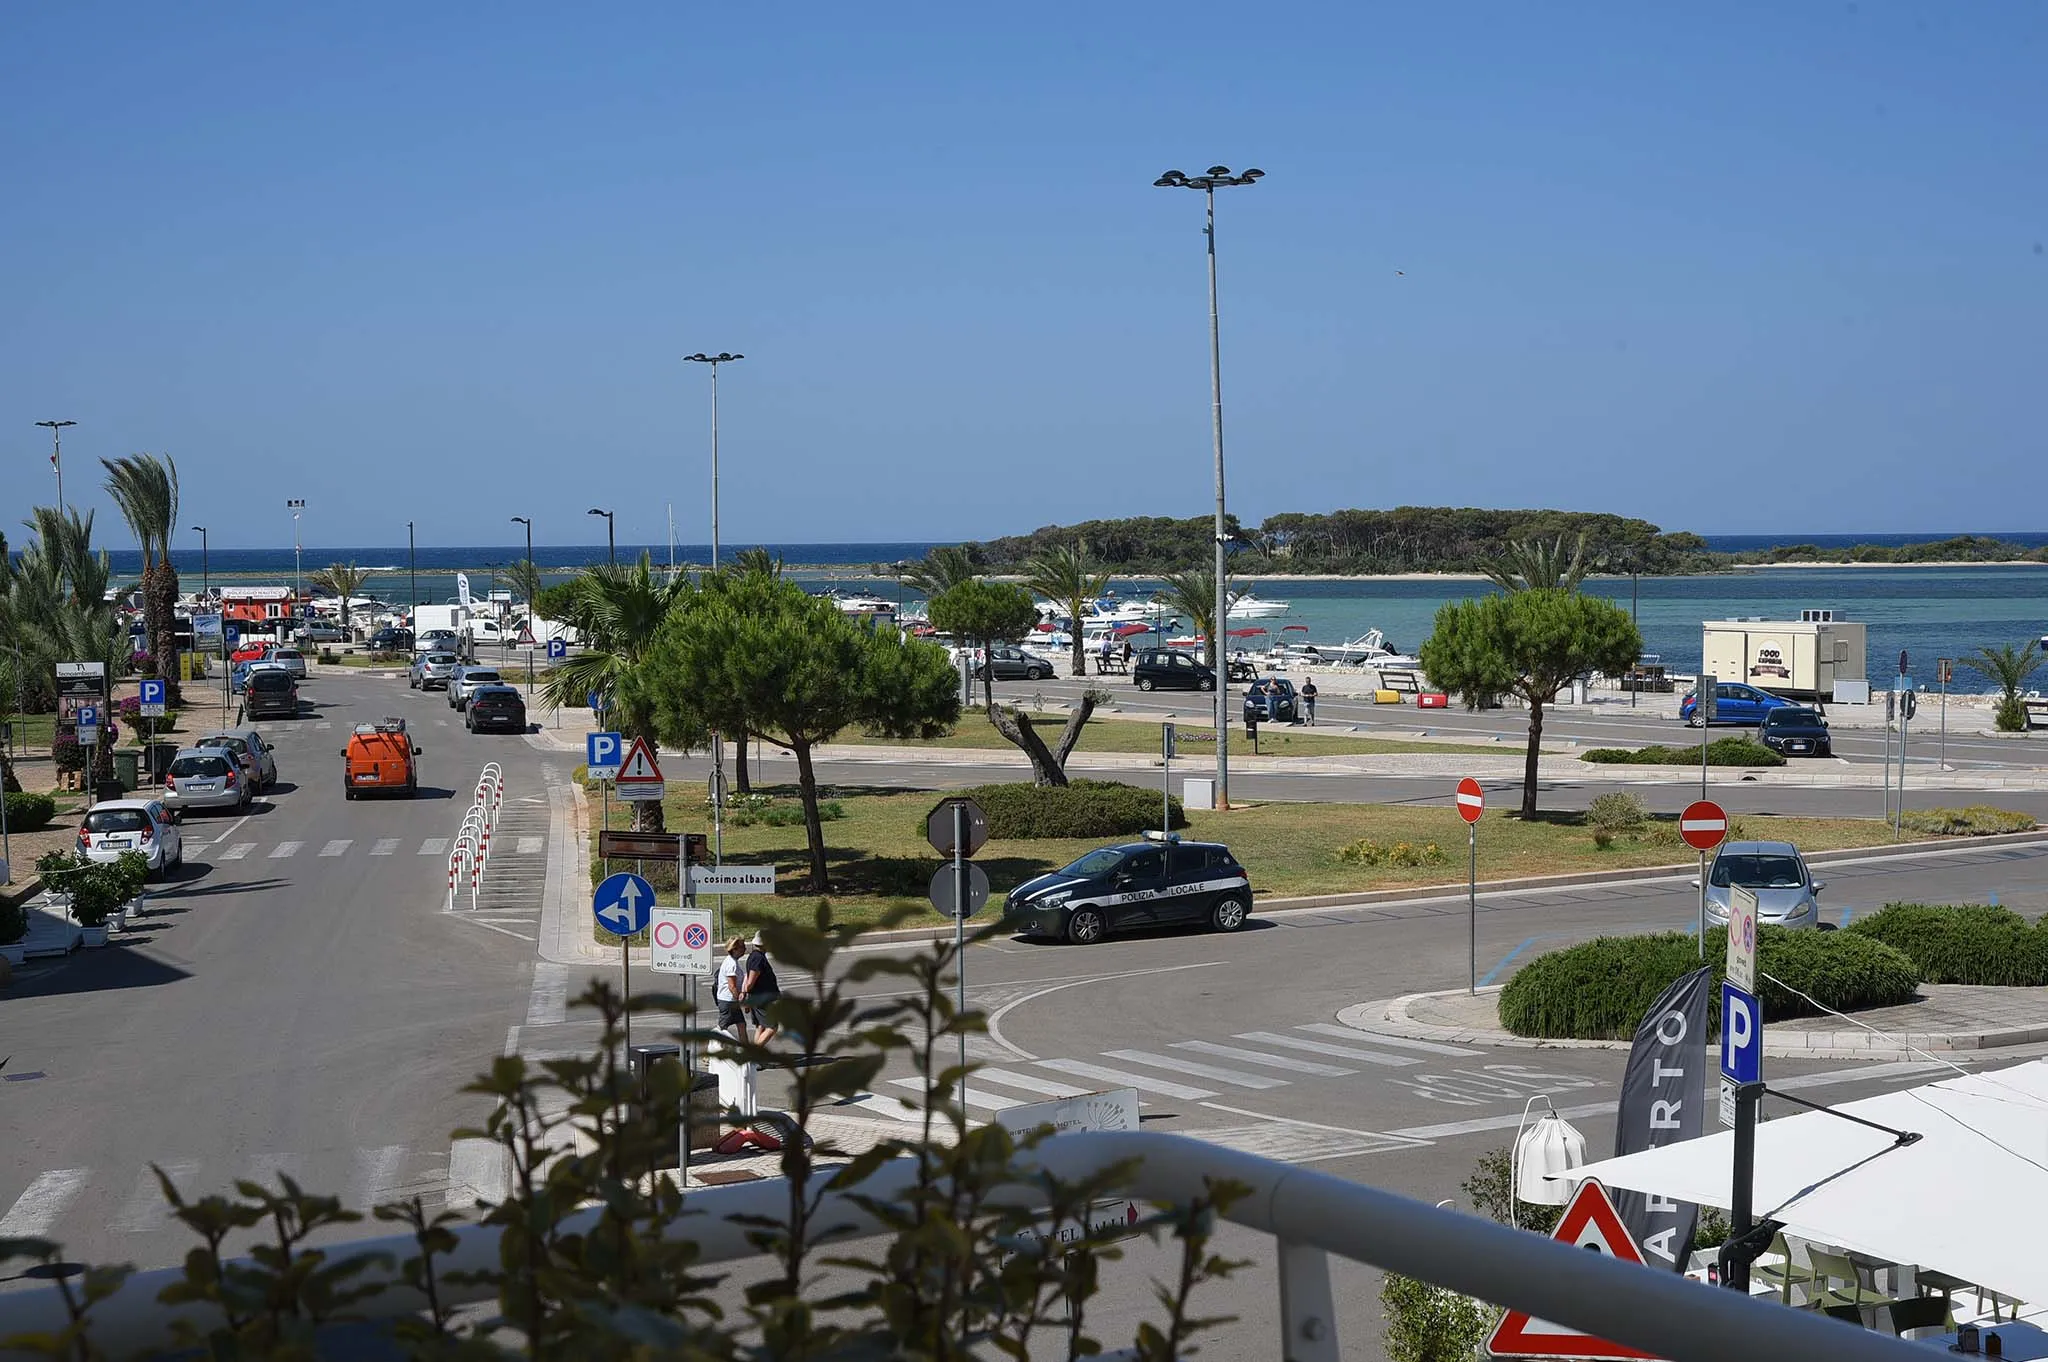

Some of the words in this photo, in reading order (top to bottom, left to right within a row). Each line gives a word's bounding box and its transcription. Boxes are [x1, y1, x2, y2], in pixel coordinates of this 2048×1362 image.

[226, 627, 236, 639] P
[551, 642, 562, 657] P
[1760, 649, 1780, 658] FOOD
[145, 683, 160, 702] P
[81, 709, 93, 724] P
[594, 736, 615, 763] P
[704, 874, 737, 884] cosimo
[739, 874, 772, 884] albano
[1121, 892, 1154, 902] POLIZIA
[1170, 883, 1204, 896] LOCALE
[1728, 994, 1752, 1070] P
[1057, 1119, 1082, 1129] HOTEL
[1643, 1008, 1688, 1264] APRTO
